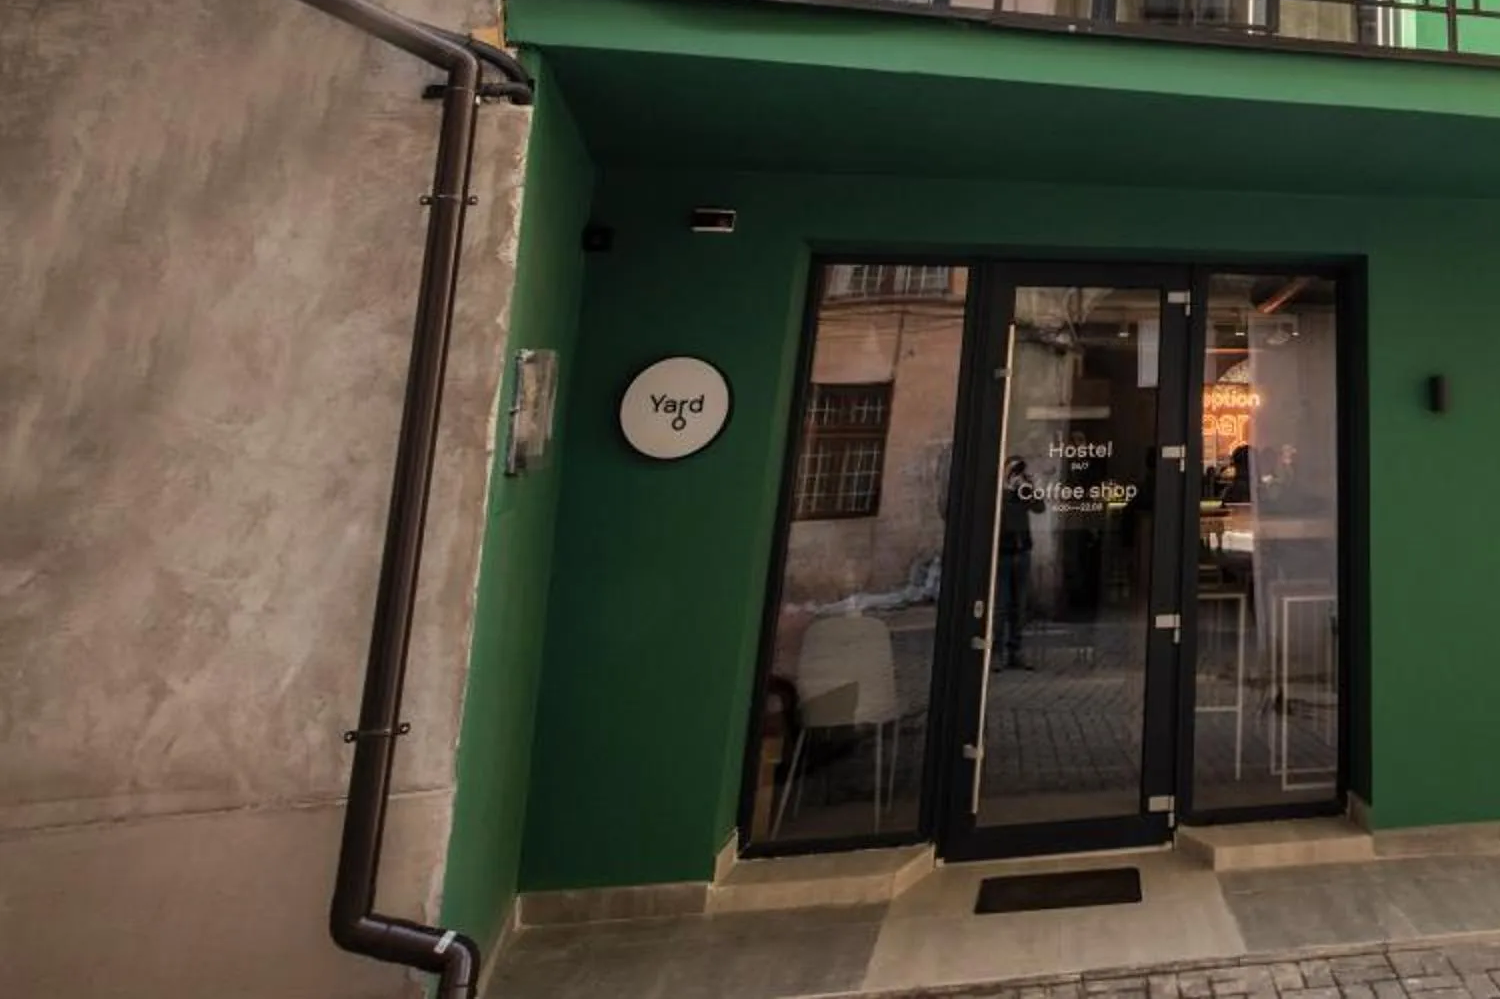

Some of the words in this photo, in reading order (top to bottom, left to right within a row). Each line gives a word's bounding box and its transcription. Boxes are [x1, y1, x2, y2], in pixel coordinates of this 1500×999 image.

[650, 394, 705, 419] Yard
[1049, 441, 1113, 458] Hostel
[1018, 483, 1085, 500] Coffee
[1089, 480, 1137, 502] shop
